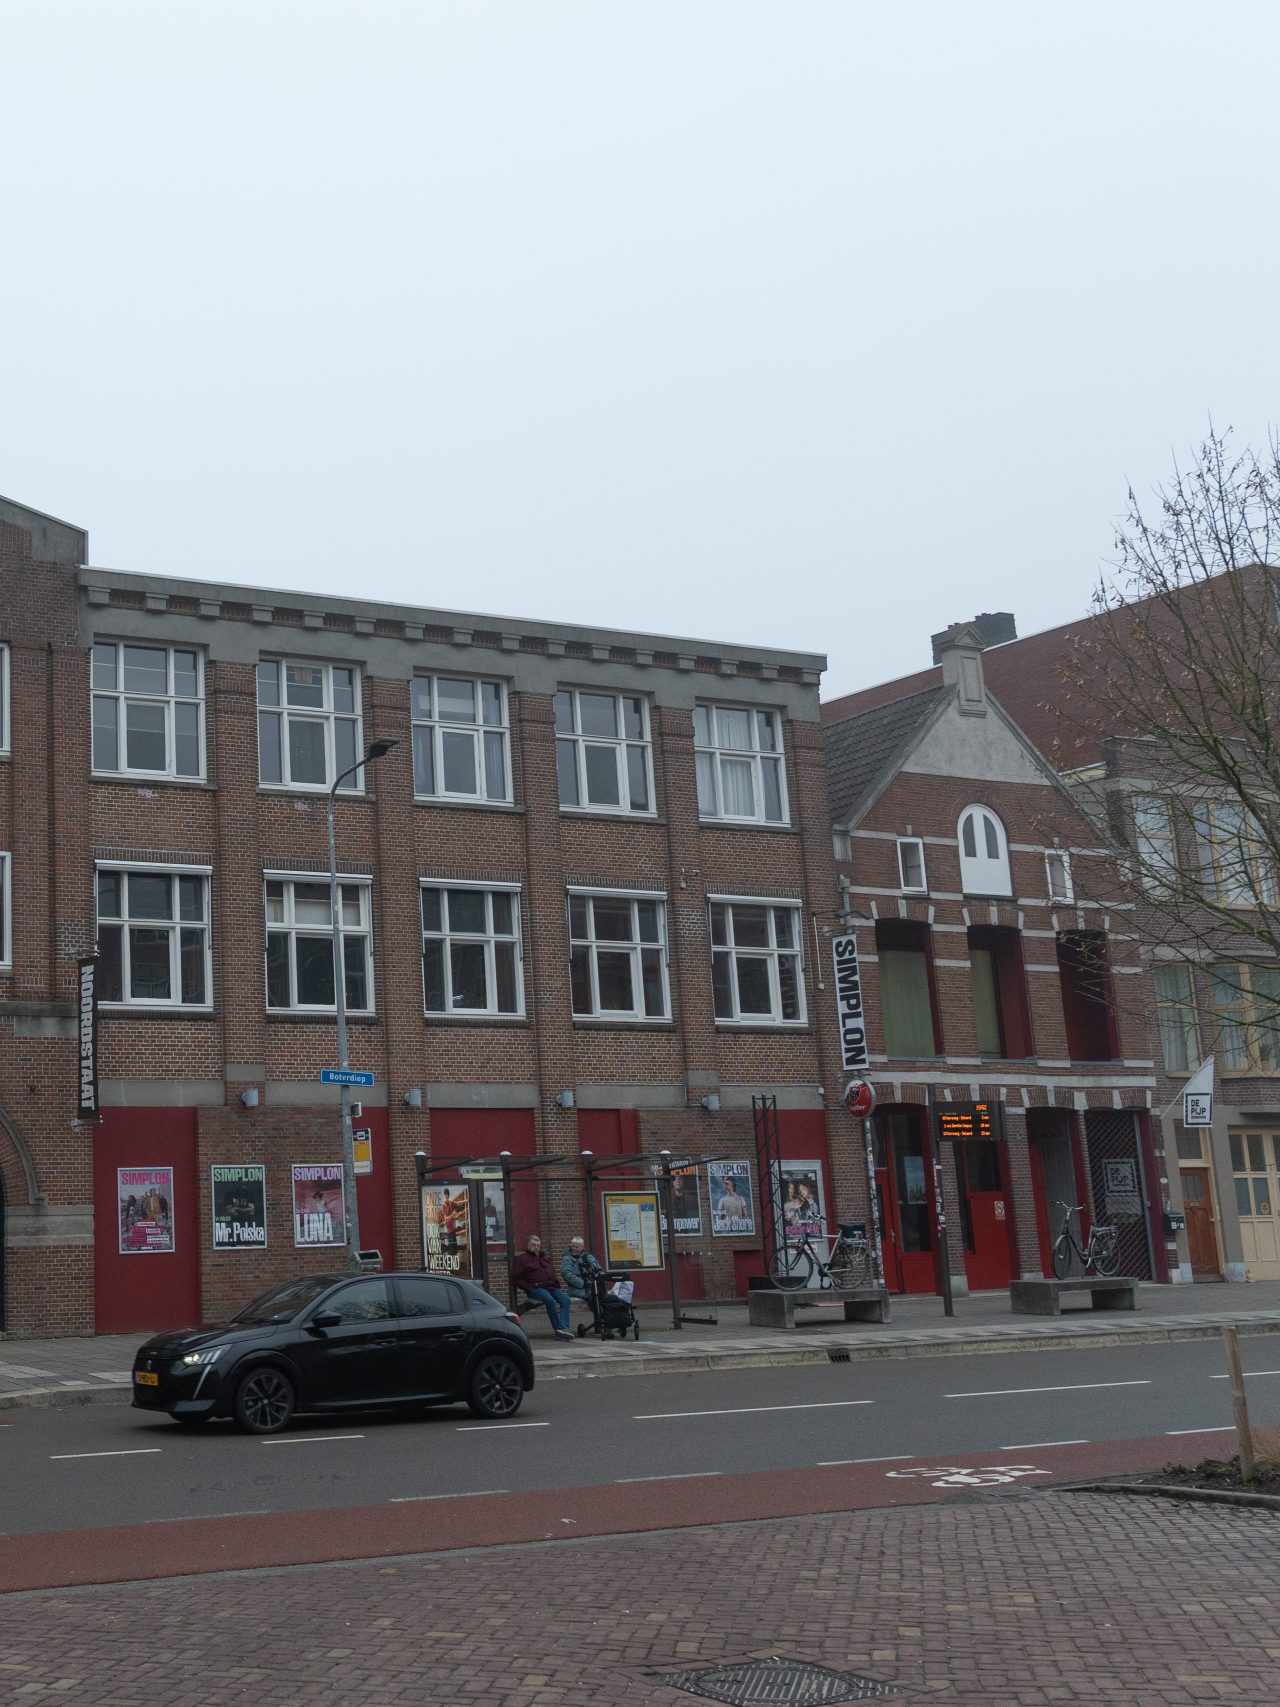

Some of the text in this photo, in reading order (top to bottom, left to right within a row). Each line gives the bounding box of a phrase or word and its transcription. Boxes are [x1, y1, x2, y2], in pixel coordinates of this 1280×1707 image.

[835, 938, 867, 1066] SIMPLON
[81, 964, 95, 1111] NOORDSTAAT
[329, 1072, 366, 1083] Boterdiep
[1191, 1099, 1200, 1107] DE
[1191, 1107, 1206, 1115] PIJP
[214, 1168, 263, 1182] SIMPLON
[294, 1167, 341, 1180] SIMPLON
[710, 1164, 748, 1176] SIMPLON
[122, 1172, 169, 1185] SIMPLON
[295, 1212, 333, 1242] LUNA
[427, 1223, 440, 1238] OOK
[714, 1215, 752, 1231] Jack Shore
[233, 1221, 265, 1242] Polska
[428, 1239, 442, 1254] VAN
[428, 1255, 460, 1270] WEEKEND
